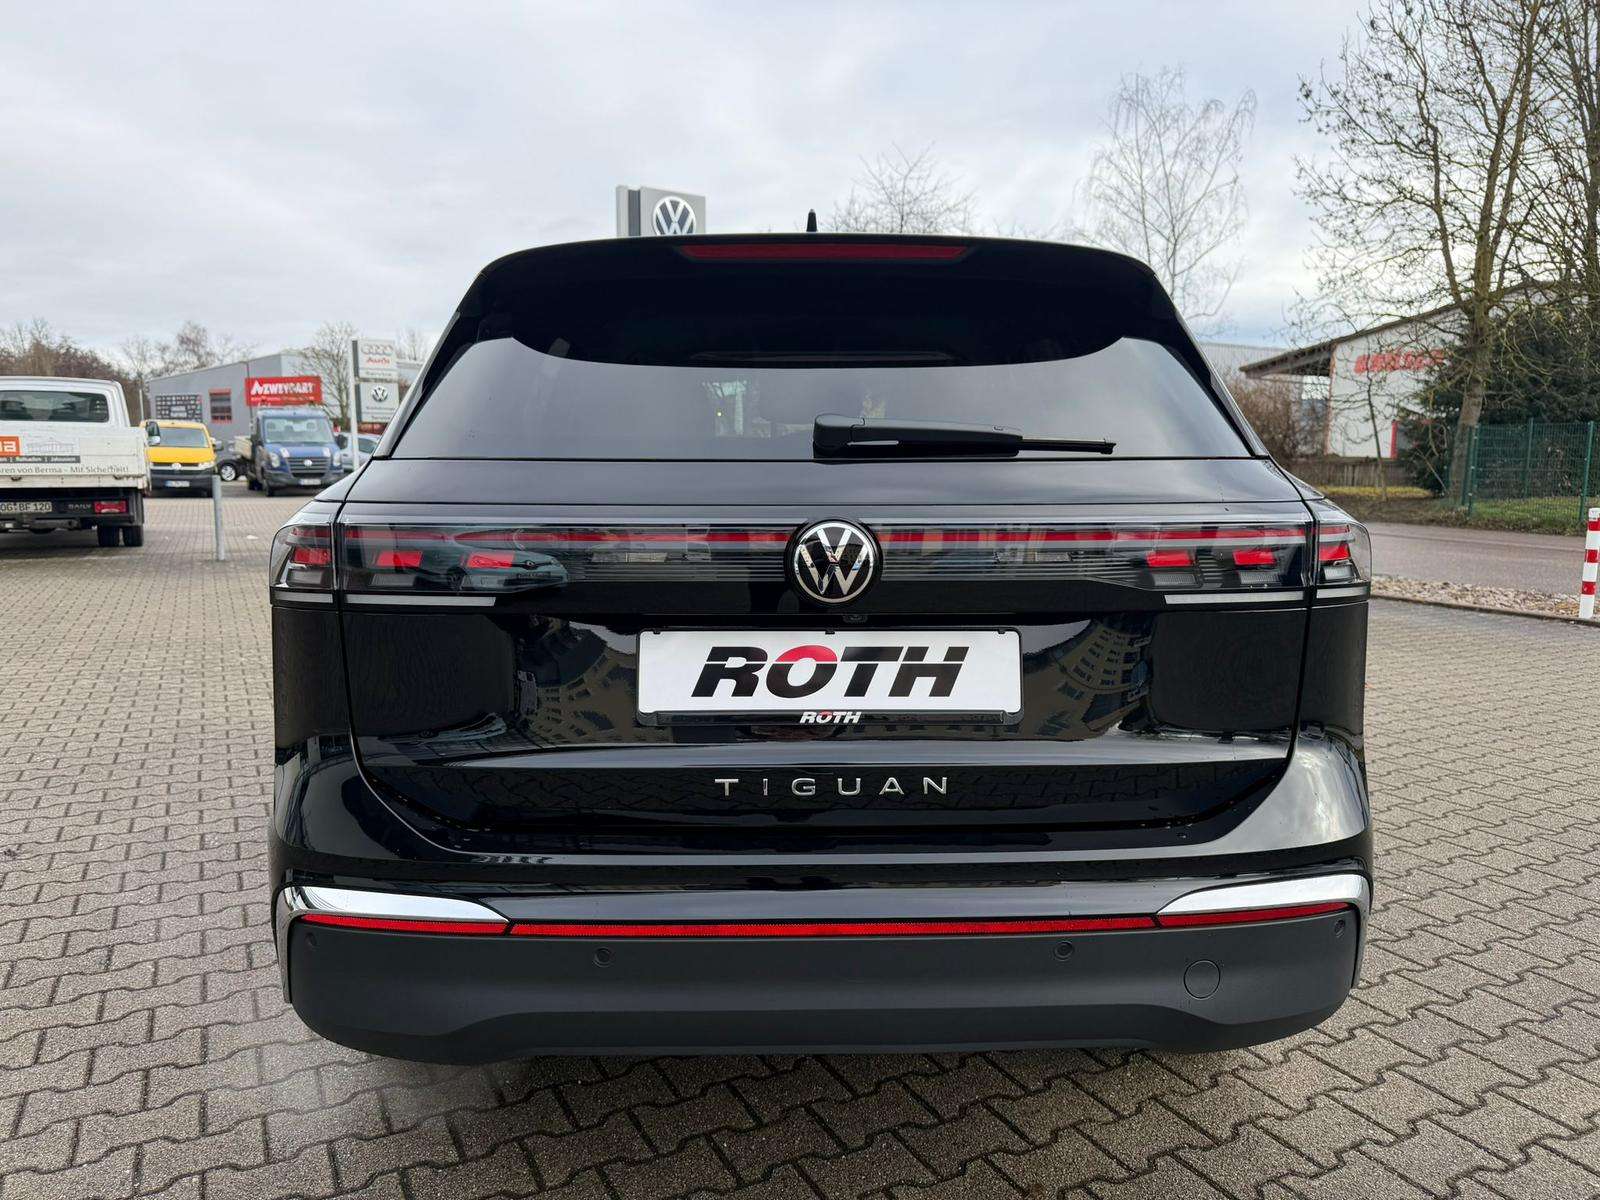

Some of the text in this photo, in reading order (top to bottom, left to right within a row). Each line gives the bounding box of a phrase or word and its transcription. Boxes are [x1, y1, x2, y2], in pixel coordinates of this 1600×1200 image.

[35, 466, 62, 474] Berma
[691, 645, 970, 698] ROTH
[799, 711, 862, 723] ROTH
[714, 777, 948, 797] TIGUAN
